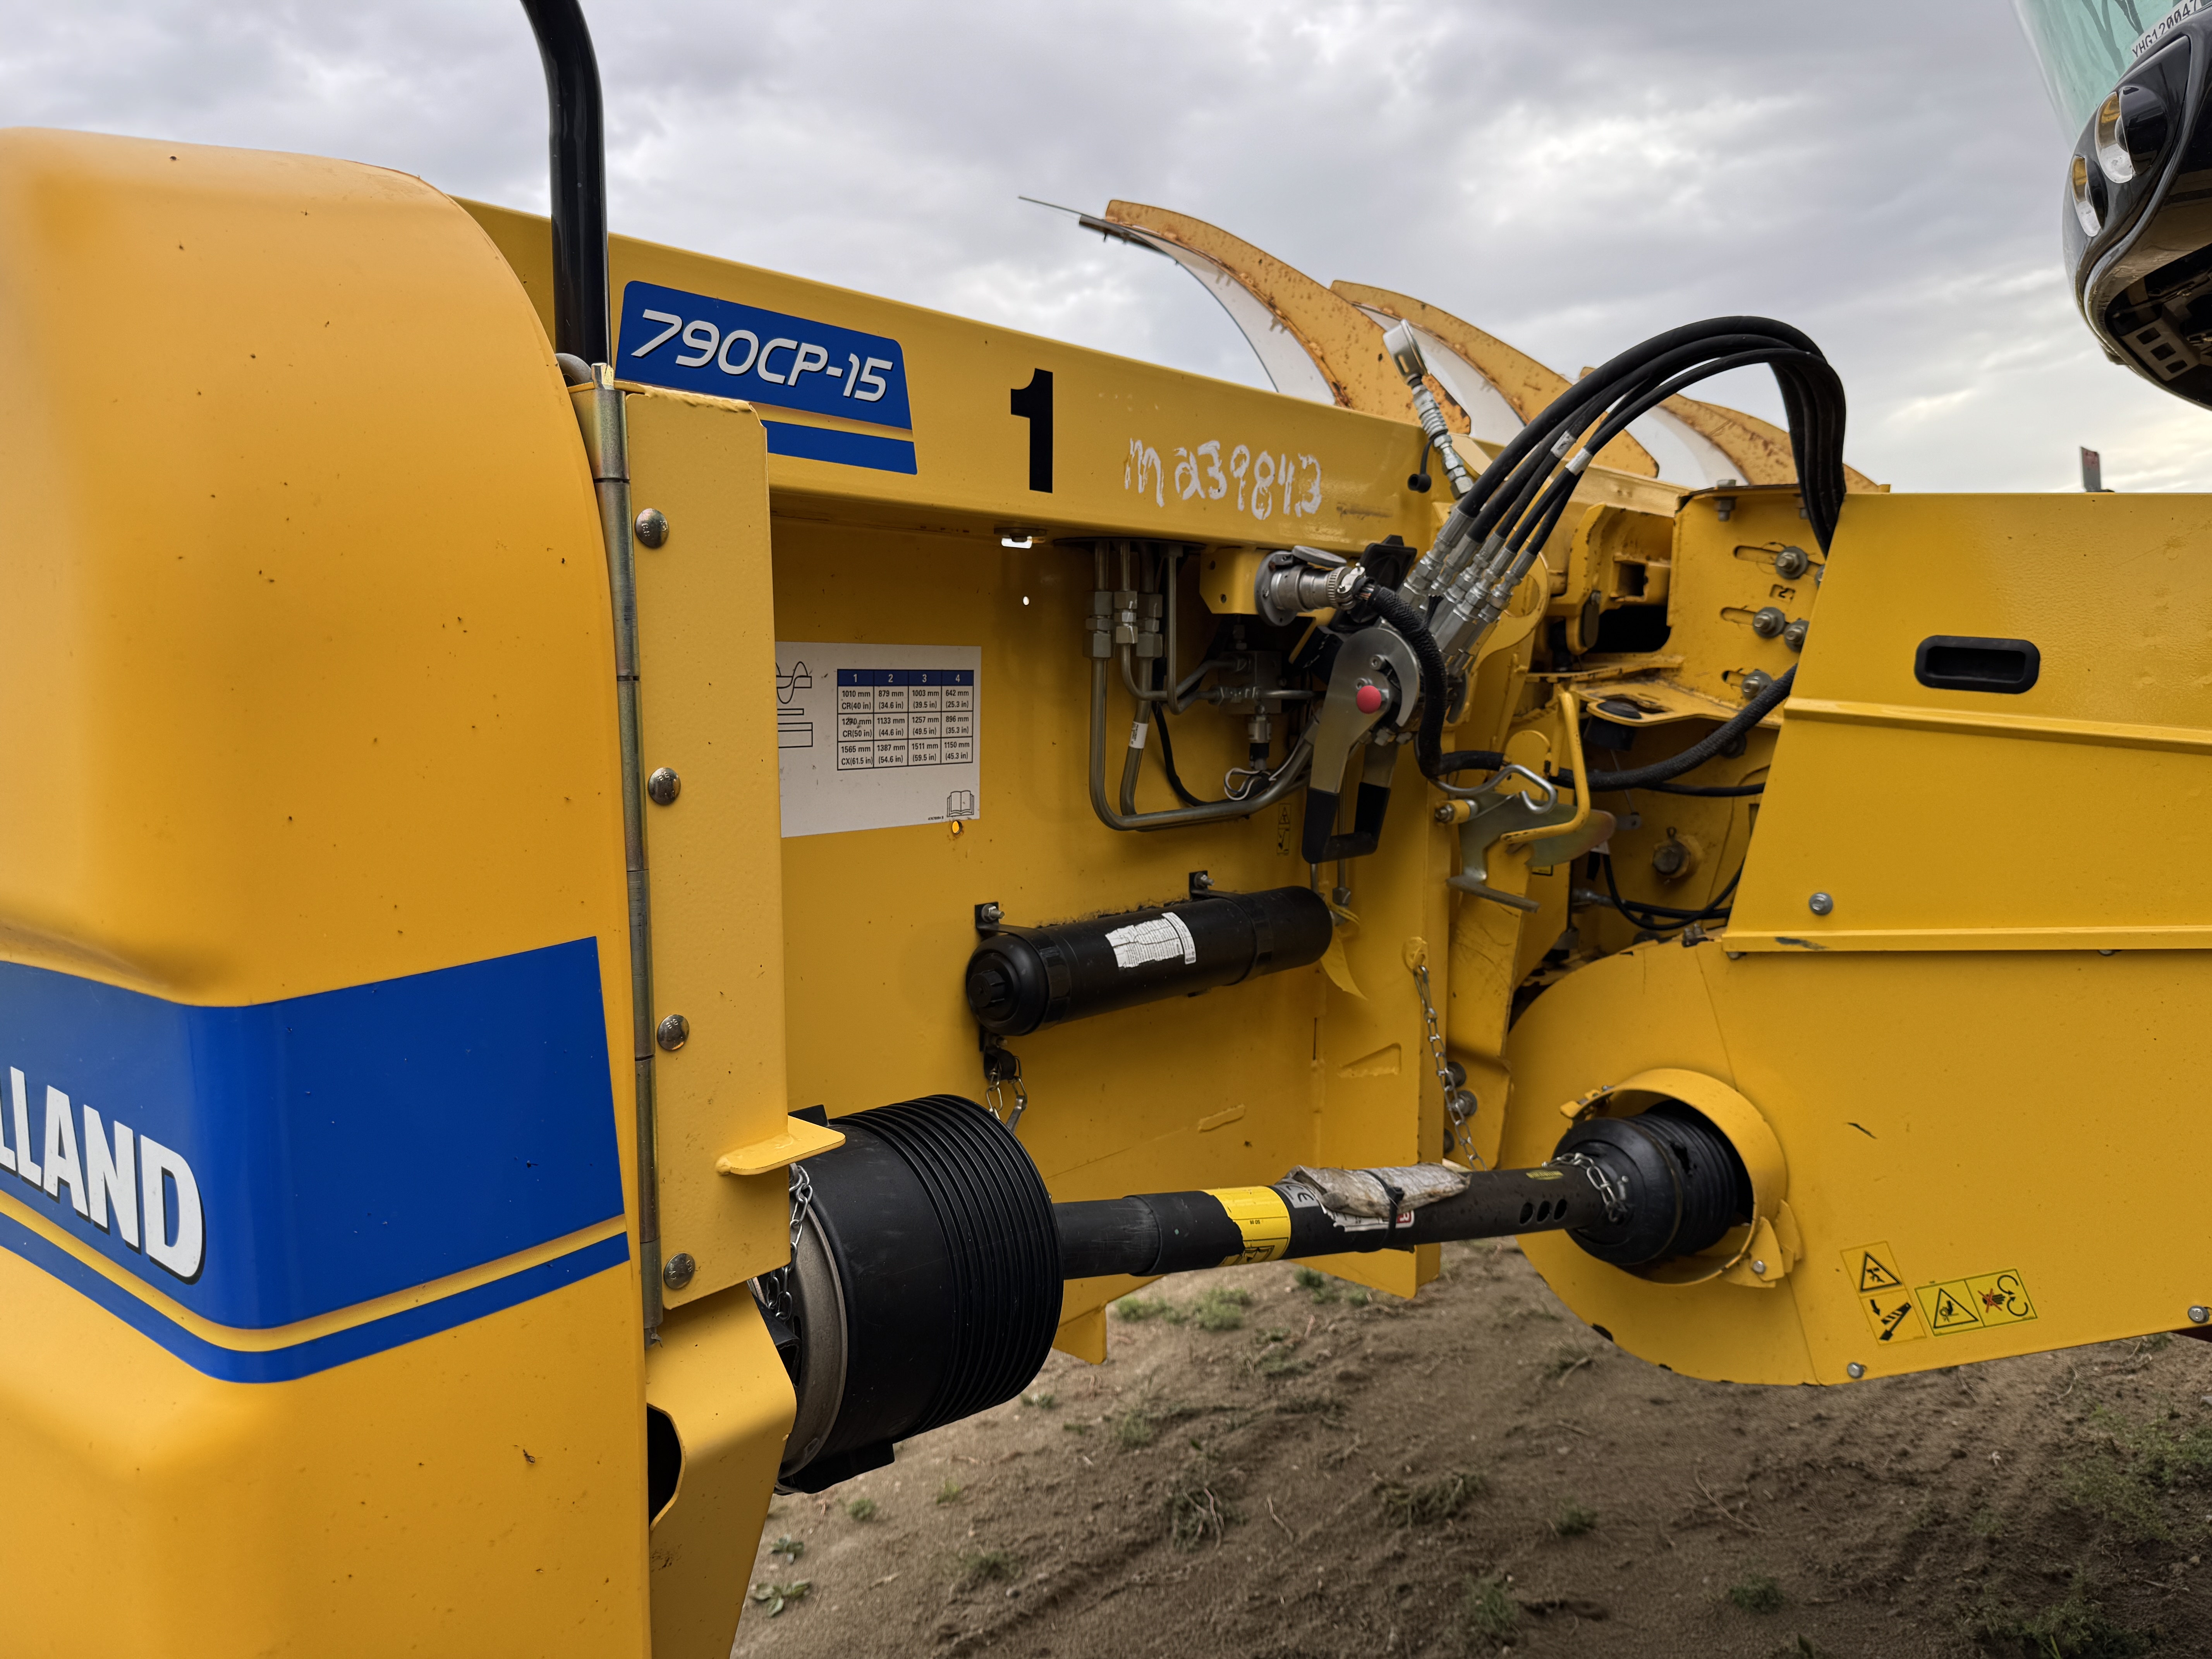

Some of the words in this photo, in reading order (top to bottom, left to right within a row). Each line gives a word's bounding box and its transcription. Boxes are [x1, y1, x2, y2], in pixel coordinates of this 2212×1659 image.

[631, 309, 893, 402] 790CP-15
[1010, 368, 1053, 493] 1
[853, 673, 857, 683] 1
[888, 674, 893, 683] 2
[922, 674, 927, 683] 3
[955, 674, 960, 683] 4
[842, 702, 861, 710] CR(40
[863, 702, 871, 710] in)
[879, 702, 894, 710] (34.6
[895, 701, 903, 709] in)
[913, 701, 927, 709] (39.5
[843, 730, 862, 738] CR(50
[864, 729, 872, 737] in)
[879, 729, 894, 737] (44.6
[879, 756, 893, 764] (54.6
[913, 754, 927, 762] (59.5
[945, 752, 959, 761] (45.3
[842, 757, 864, 766] CX(61.5
